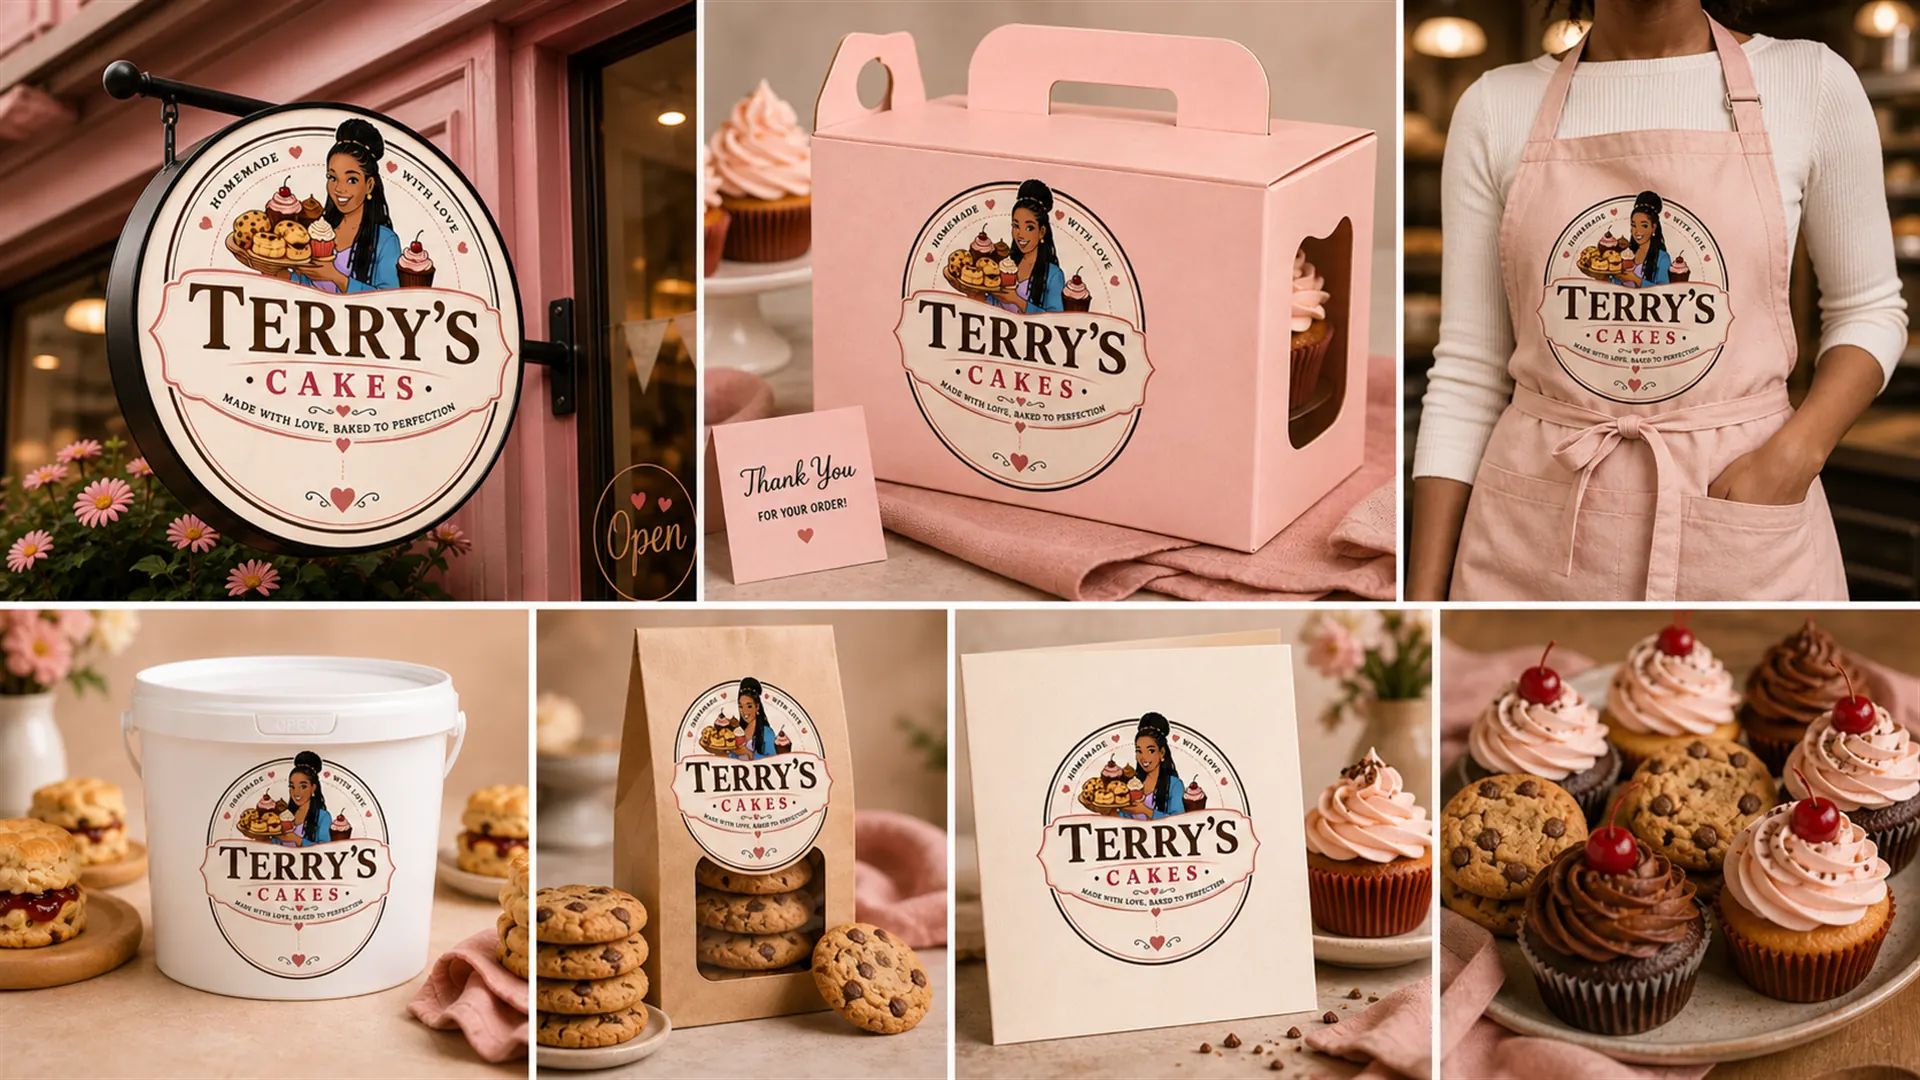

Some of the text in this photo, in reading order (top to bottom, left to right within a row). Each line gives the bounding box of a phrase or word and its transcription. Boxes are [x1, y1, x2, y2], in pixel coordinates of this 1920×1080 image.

[209, 152, 280, 210] HOMEMADE
[402, 169, 459, 234] WITH LOVE
[932, 204, 979, 249] HOMEMADE
[1067, 216, 1113, 271] WITH LOVE
[188, 282, 480, 365] TERRY'S
[1557, 285, 1715, 325] TERRY'S
[918, 299, 1127, 375] TERRY'S
[1596, 329, 1676, 345] CAKES
[266, 369, 414, 400] CAKES
[940, 380, 962, 399] MADE
[963, 393, 985, 409] WITH
[1013, 410, 1041, 421] BAKED
[1043, 413, 1054, 422] TO
[1056, 404, 1106, 422] PERFECTION
[967, 365, 1073, 399] CAKES
[222, 393, 456, 434] MADE WITH LOVE, BAKED TO PERFECTION
[739, 454, 857, 498] Thank You
[758, 497, 848, 522] FOR YOUR ORDER!
[607, 510, 688, 577] Open
[277, 719, 318, 732] OPEN
[685, 757, 817, 793] TERRY'S
[1067, 740, 1108, 781] HOMEMADE
[1182, 738, 1222, 775] WITH LOVE
[721, 796, 787, 812] CAKES
[1058, 816, 1239, 863] TERRY'S
[218, 844, 378, 881] TERRY'S
[1106, 865, 1198, 887] CAKES
[257, 887, 339, 902] CAKES
[1081, 888, 1102, 900] MADE
[1104, 895, 1124, 905] WITH
[1174, 894, 1185, 903] TO
[317, 912, 326, 920] TO
